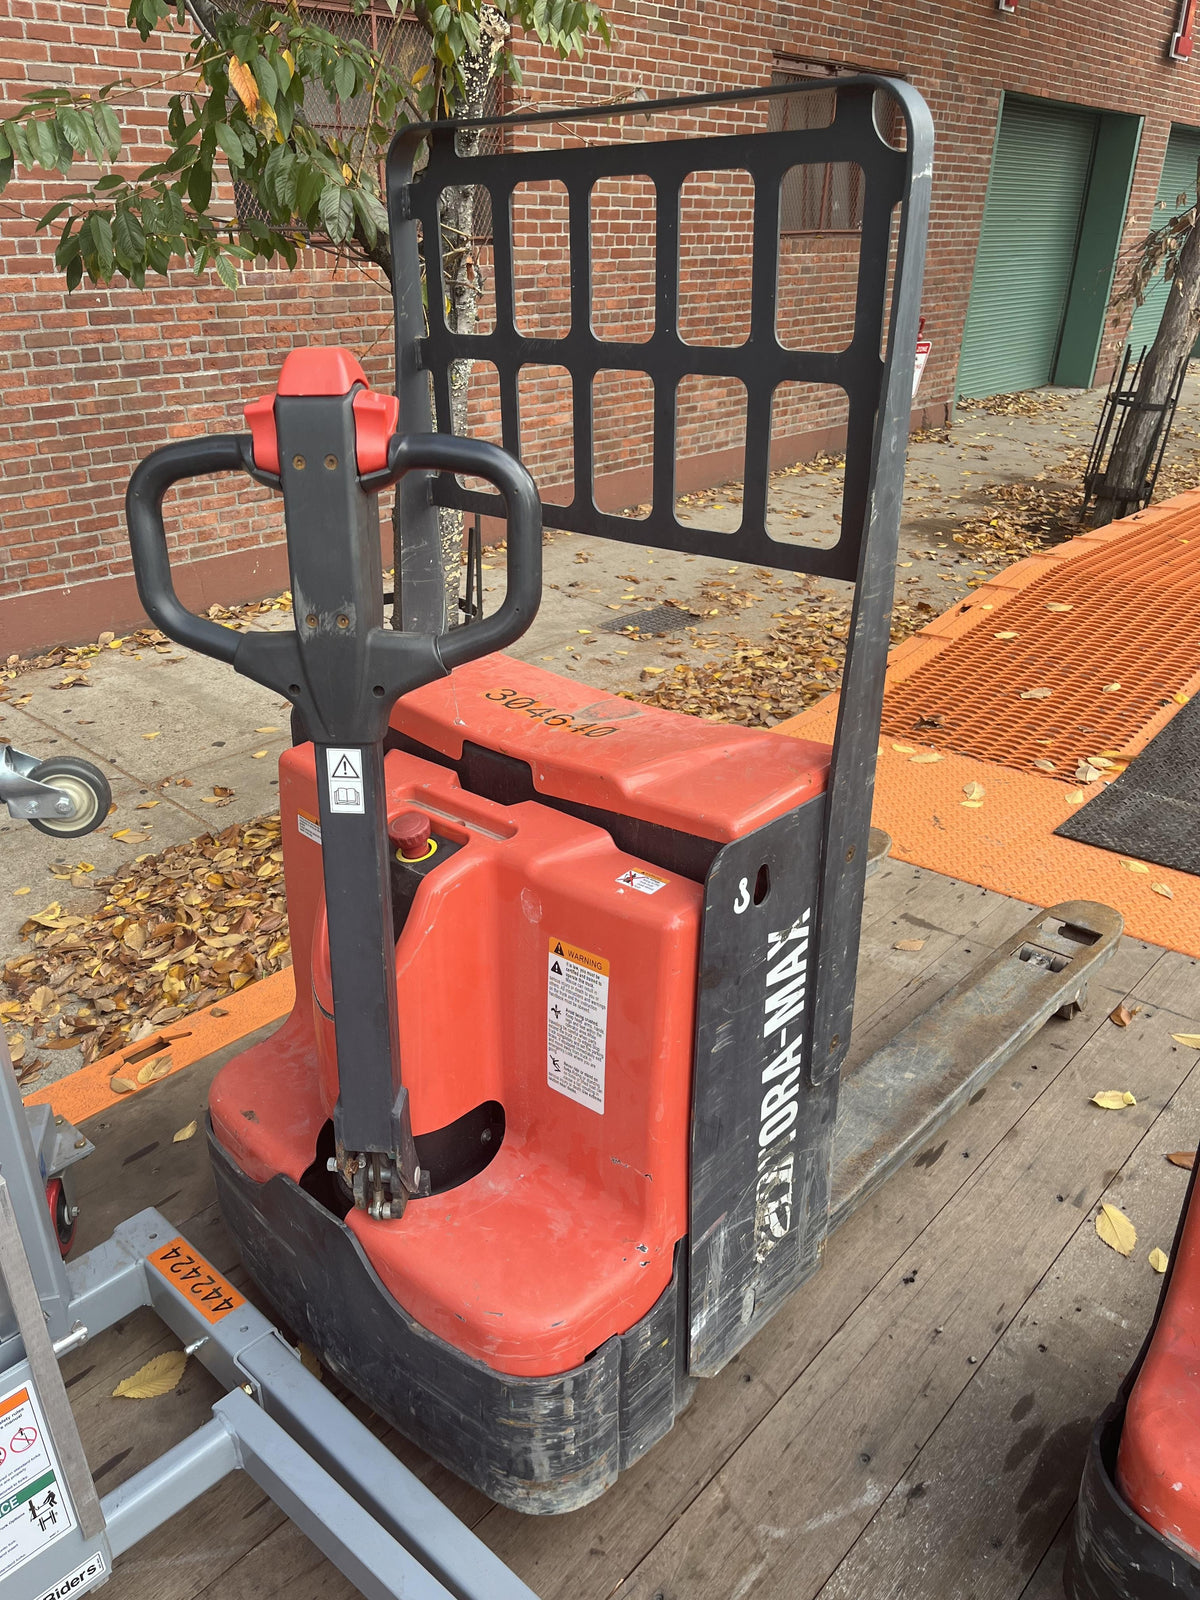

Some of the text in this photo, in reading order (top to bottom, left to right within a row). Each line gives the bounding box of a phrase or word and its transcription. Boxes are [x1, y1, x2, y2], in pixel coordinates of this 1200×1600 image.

[567, 949, 603, 971] WARNING
[160, 1246, 234, 1312] 442424
[42, 1564, 97, 1600] Riders
